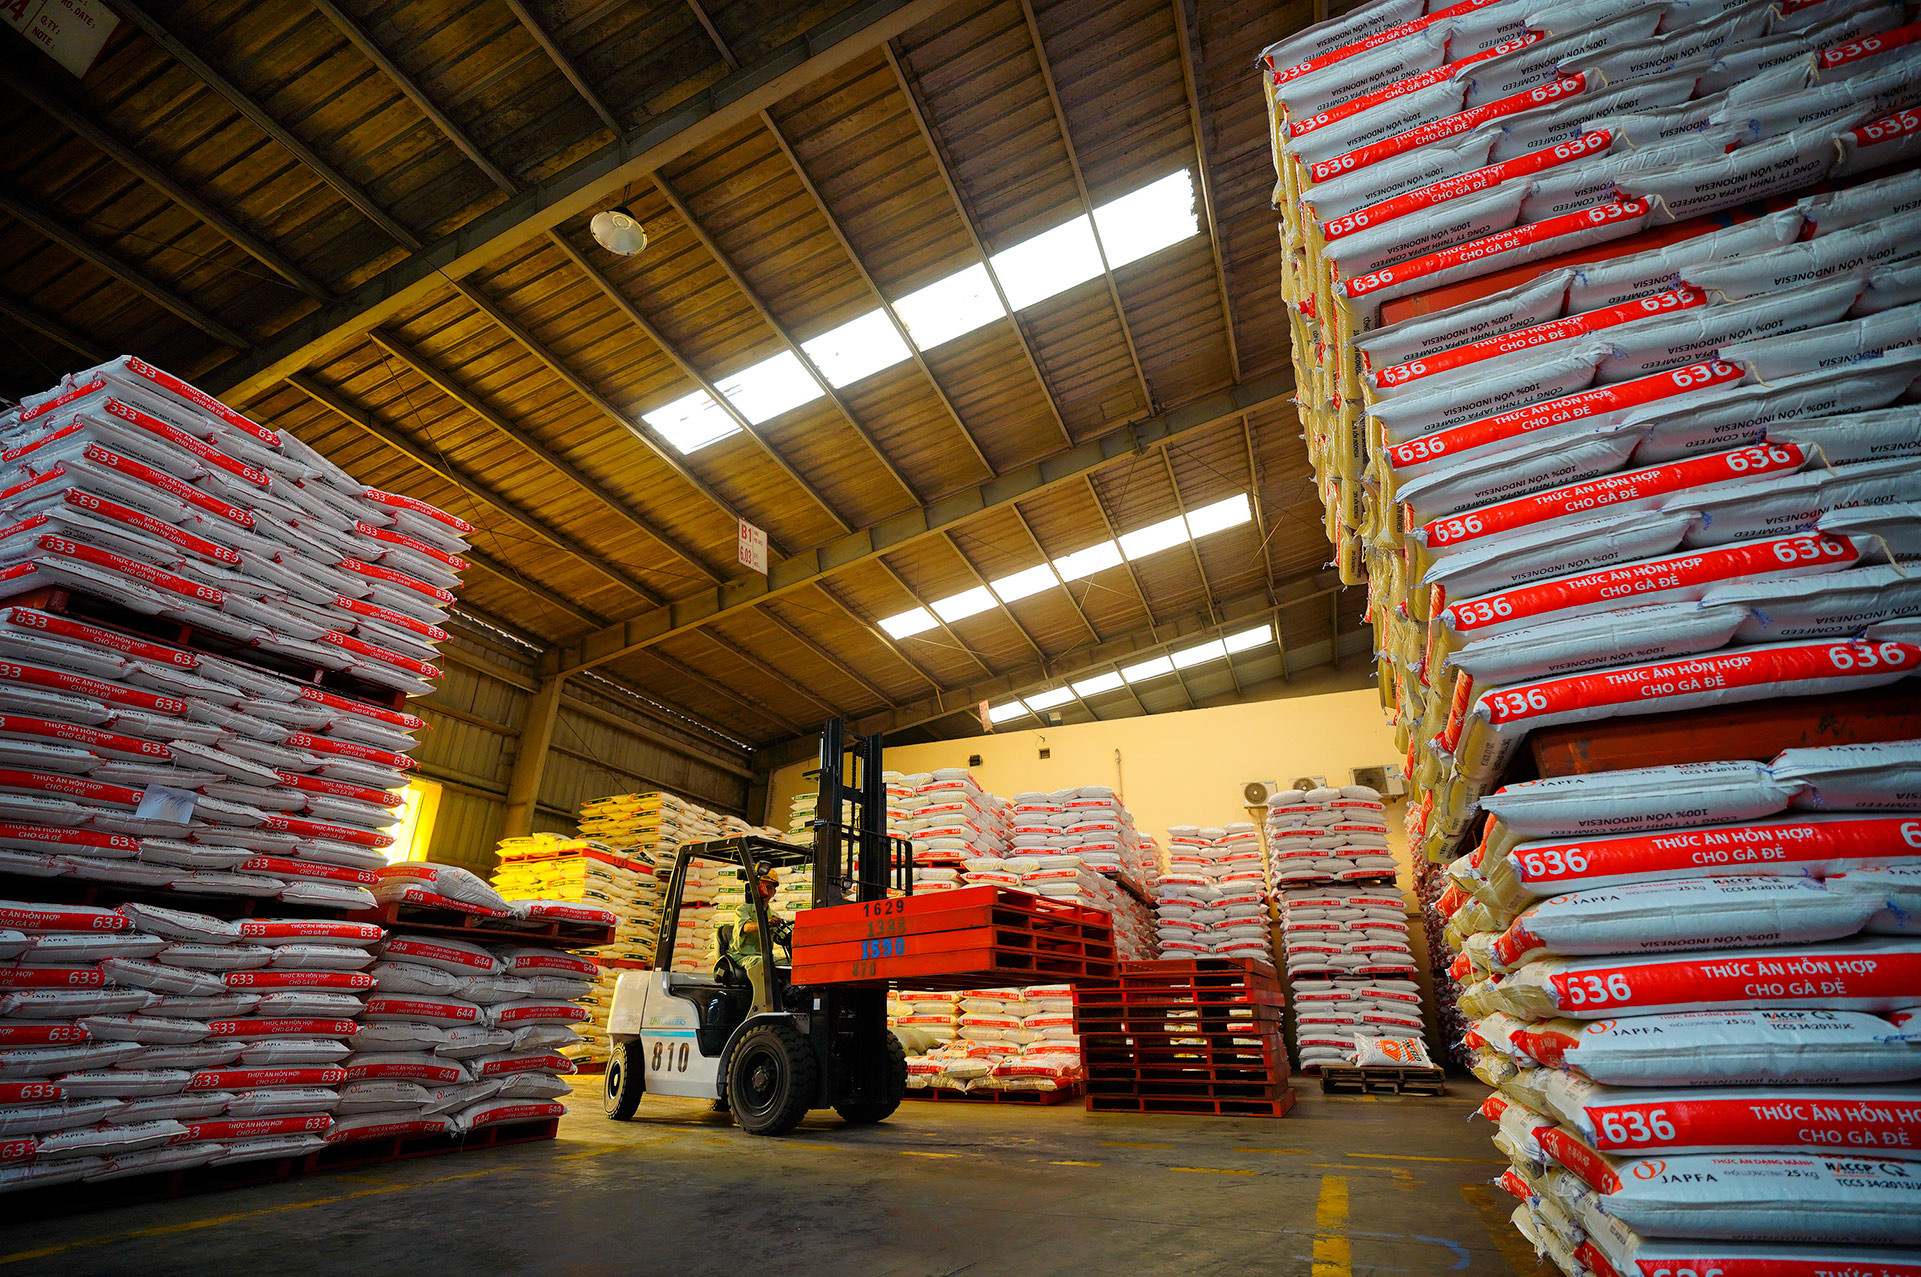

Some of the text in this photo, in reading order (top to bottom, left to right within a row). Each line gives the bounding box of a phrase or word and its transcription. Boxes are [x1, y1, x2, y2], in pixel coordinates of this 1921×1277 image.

[40, 15, 60, 35] Q.TY:
[1369, 79, 1389, 91] TNHH
[1389, 75, 1399, 83] TY
[1531, 72, 1577, 102] 636
[1349, 86, 1370, 98] JAPFA
[1316, 94, 1349, 110] COMFEED
[1553, 131, 1602, 160] 636
[1316, 155, 1355, 178] 636
[1773, 155, 1800, 170] 100%
[1694, 171, 1748, 194] INDONESIA
[1748, 174, 1776, 191] TNHH
[1777, 171, 1789, 180] TY
[1668, 189, 1717, 209] COMFEED
[1718, 182, 1748, 200] JAPFA
[1589, 200, 1640, 223] 636
[1328, 212, 1369, 235] 636
[1353, 269, 1394, 292] 636
[1640, 289, 1695, 311] 636
[1384, 361, 1426, 383] 636
[1671, 361, 1732, 388] 636
[1515, 382, 1541, 395] 100%
[1442, 397, 1492, 416] INDONESIA
[1495, 399, 1520, 411] TNHH
[1522, 395, 1534, 403] TY
[1467, 406, 1494, 419] JAPFA
[1492, 409, 1529, 425] THỨC
[1520, 402, 1592, 430] CHO GÀ ĐẺ
[1423, 414, 1466, 431] COMFEED
[89, 448, 118, 466] 633
[1398, 436, 1445, 462] 636
[1725, 444, 1790, 472] 636
[242, 468, 266, 486] 633
[367, 490, 386, 501] 633
[1533, 488, 1573, 505] THỨC
[1630, 469, 1662, 485] HỢP
[1564, 484, 1639, 512] CHO GÀ ĐẺ
[359, 523, 378, 536] 633
[741, 523, 752, 542] B1
[1435, 514, 1483, 543] 636
[46, 538, 76, 554] 633
[1773, 535, 1844, 563] 636
[1565, 573, 1608, 589] THỨC
[1609, 568, 1632, 581] ĂN
[1670, 556, 1705, 572] HỢP
[1599, 571, 1680, 597] CHO GÀ ĐẺ
[1458, 597, 1512, 625] 636
[15, 613, 48, 628] 633
[1828, 643, 1905, 669] 636
[1604, 655, 1753, 685] THỨC ĂN HỖN HỢP
[71, 684, 87, 693] CHO
[1641, 670, 1726, 696] CHO GÀ ĐẺ
[154, 698, 182, 712] 633
[290, 733, 312, 747] 633
[1578, 815, 1642, 827] INDONESIA
[1675, 808, 1707, 818] 100%
[1651, 825, 1816, 849] THỨC ĂN HỖN HỢP
[1692, 842, 1786, 864] CHO GÀ ĐẺ
[1524, 848, 1588, 877] 636
[1573, 894, 1619, 904] JAPFA
[863, 900, 904, 917] 1629
[93, 917, 123, 929] 633
[243, 925, 266, 936] 633
[861, 937, 905, 959] 1590
[474, 956, 490, 967] 644
[852, 962, 877, 977] 870
[1700, 956, 1879, 978] THỨC ĂN HỖN HỢP
[1567, 973, 1632, 1004] 636
[1744, 977, 1847, 996] CHO GÀ ĐẺ
[456, 1009, 473, 1018] 644
[570, 1009, 583, 1018] 644
[1761, 1011, 1804, 1019] HACCP
[49, 1027, 81, 1041] 633
[335, 1022, 354, 1032] 633
[1612, 1026, 1663, 1036] JAPFA
[652, 1042, 689, 1072] 810
[439, 1070, 456, 1081] 644
[20, 1085, 54, 1099] 633
[1749, 1102, 1809, 1121] THỨC
[1810, 1103, 1842, 1121] ĂN
[1844, 1101, 1895, 1123] HỖN
[1602, 1109, 1676, 1143] 636
[1798, 1126, 1913, 1145] CHO GÀ ĐẺ
[1784, 1169, 1800, 1177] 25
[1802, 1169, 1819, 1179] kg
[1824, 1162, 1872, 1172] HACCP
[1661, 1172, 1718, 1184] JAPFA
[1835, 1178, 1864, 1187] TCCS
